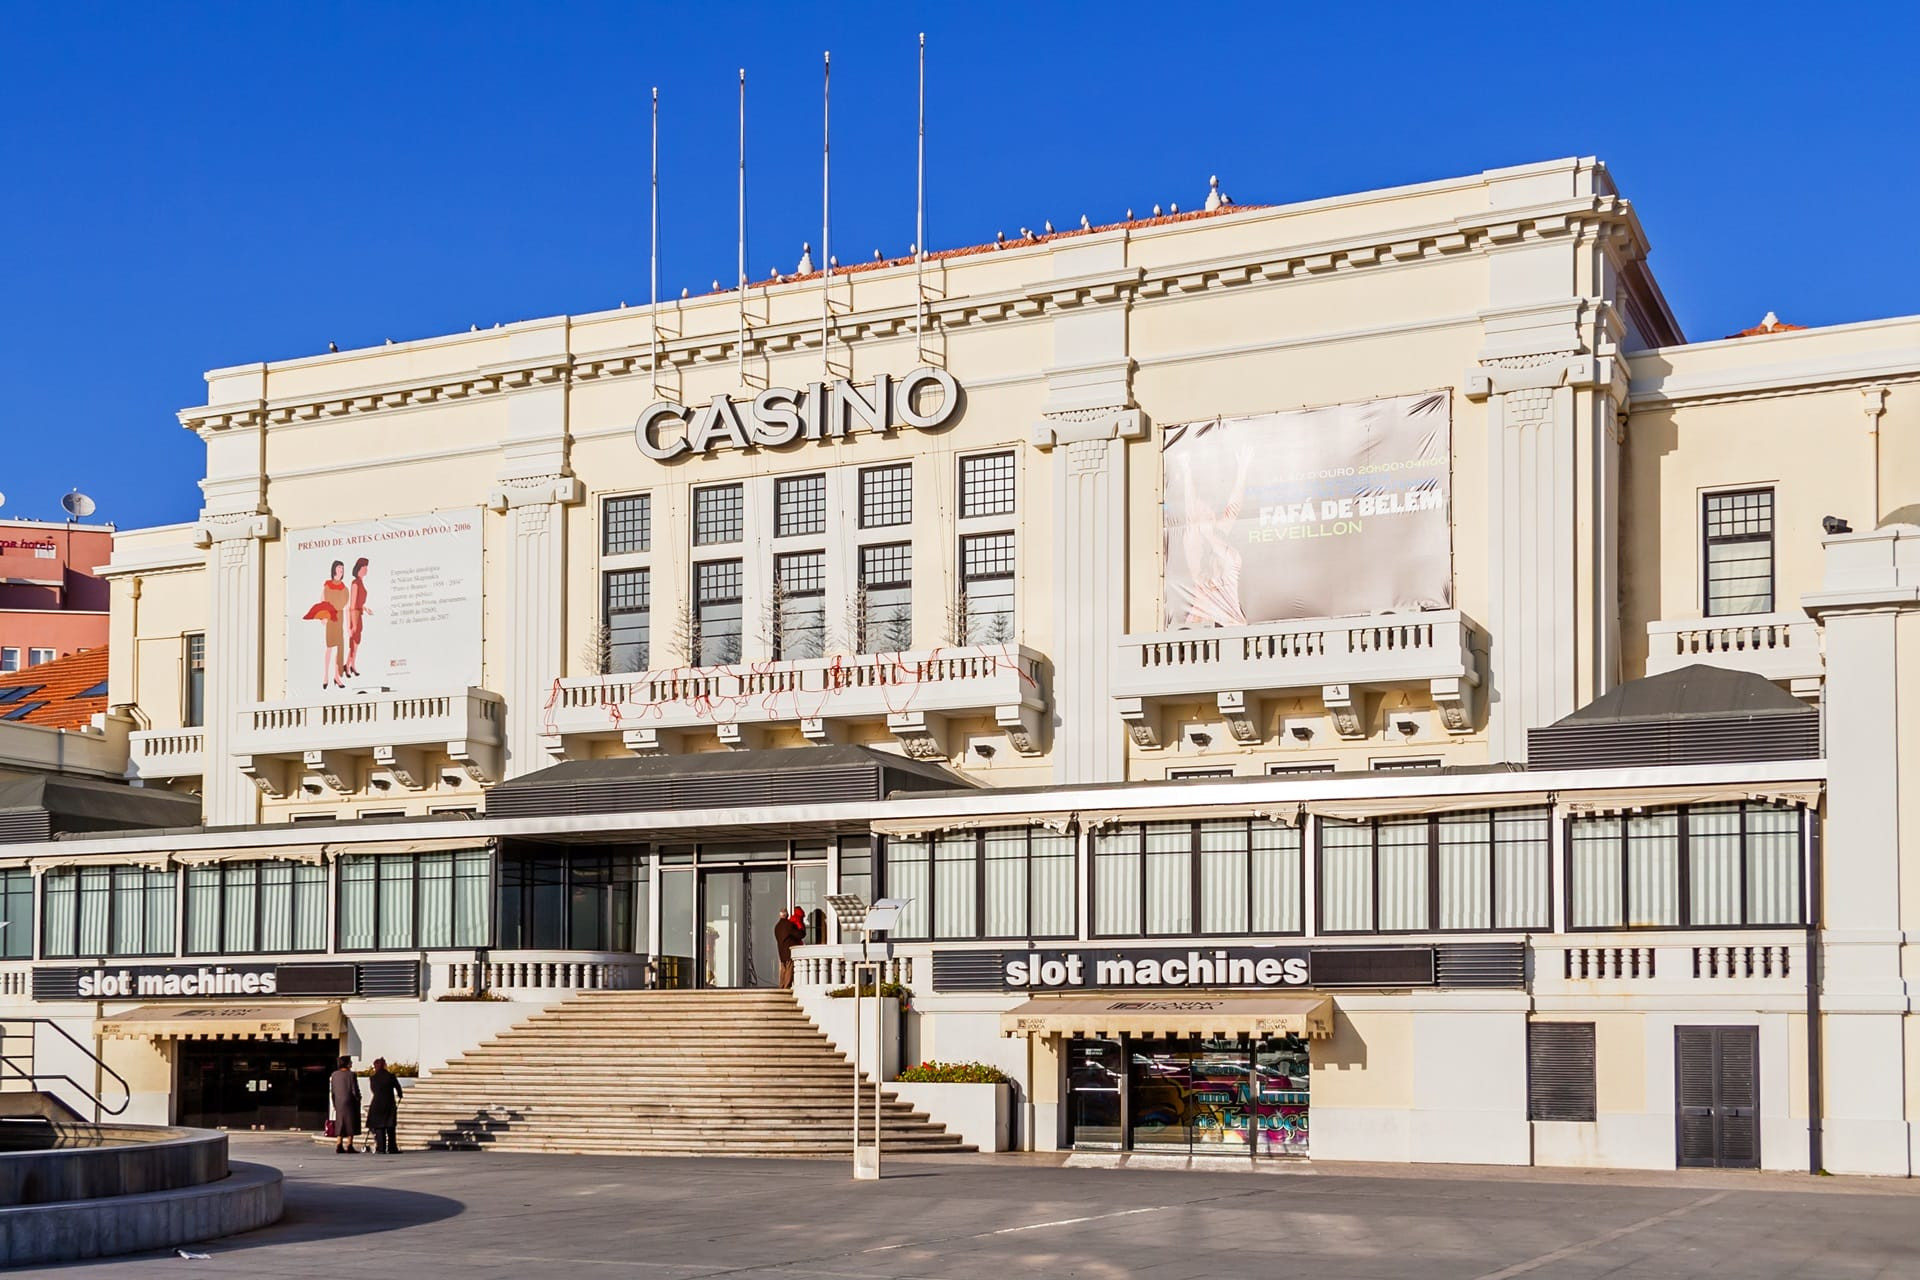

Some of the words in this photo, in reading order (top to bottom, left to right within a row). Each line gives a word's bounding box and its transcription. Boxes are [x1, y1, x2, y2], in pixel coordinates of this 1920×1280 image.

[635, 366, 959, 460] CASINO
[1259, 496, 1315, 527] FAFÁ
[1321, 498, 1353, 521] DE
[1359, 487, 1443, 517] BELÉM
[20, 538, 56, 551] hotels
[298, 539, 331, 551] PRÉMIO
[332, 537, 344, 546] DE
[346, 535, 374, 545] ARTES
[374, 531, 407, 541] CASINO
[408, 529, 420, 537] DA
[454, 523, 472, 532] 2006
[1249, 519, 1363, 544] RÉVEILLON
[78, 970, 132, 996] slot
[138, 966, 277, 995] machines
[1006, 953, 1084, 986] slot
[1096, 950, 1309, 985] machines
[1194, 1114, 1218, 1130] de
